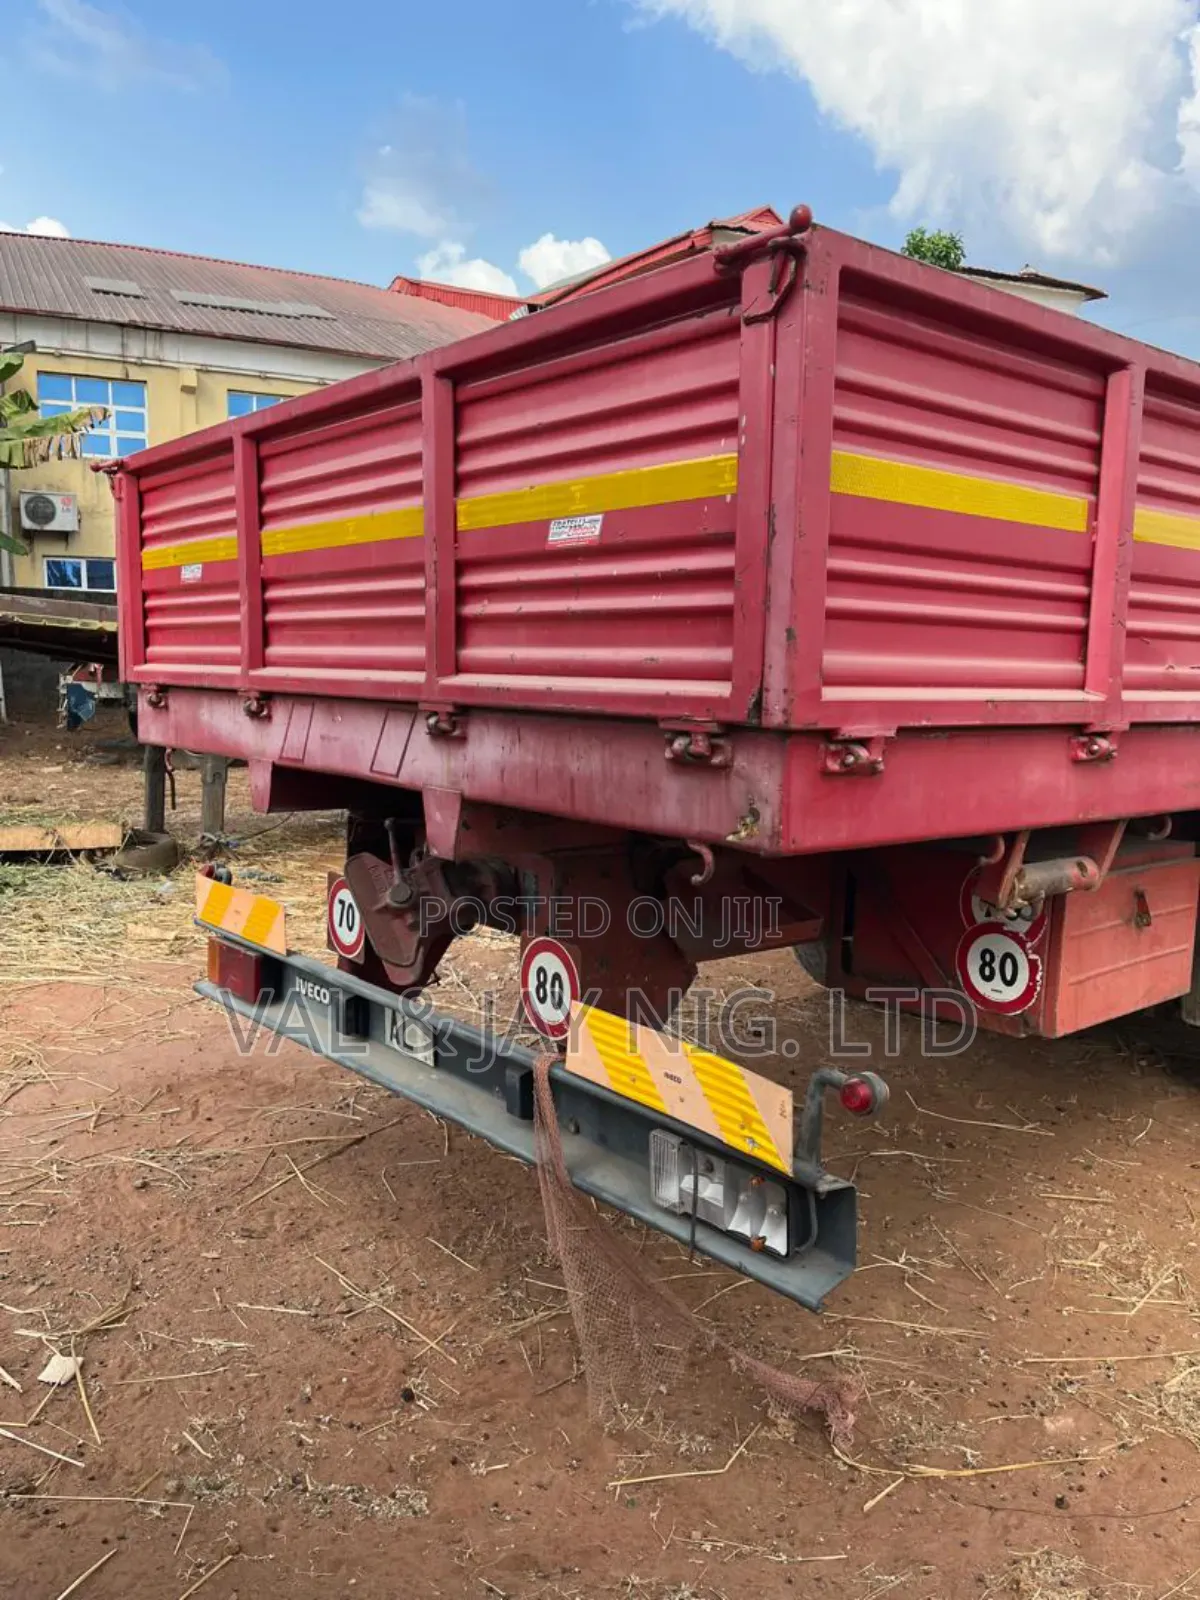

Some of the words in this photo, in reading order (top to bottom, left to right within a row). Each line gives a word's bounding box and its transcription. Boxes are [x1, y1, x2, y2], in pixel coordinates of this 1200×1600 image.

[338, 898, 356, 933] 70
[979, 947, 1019, 987] 80
[295, 976, 330, 1004] IVECO
[535, 965, 564, 1010] 80
